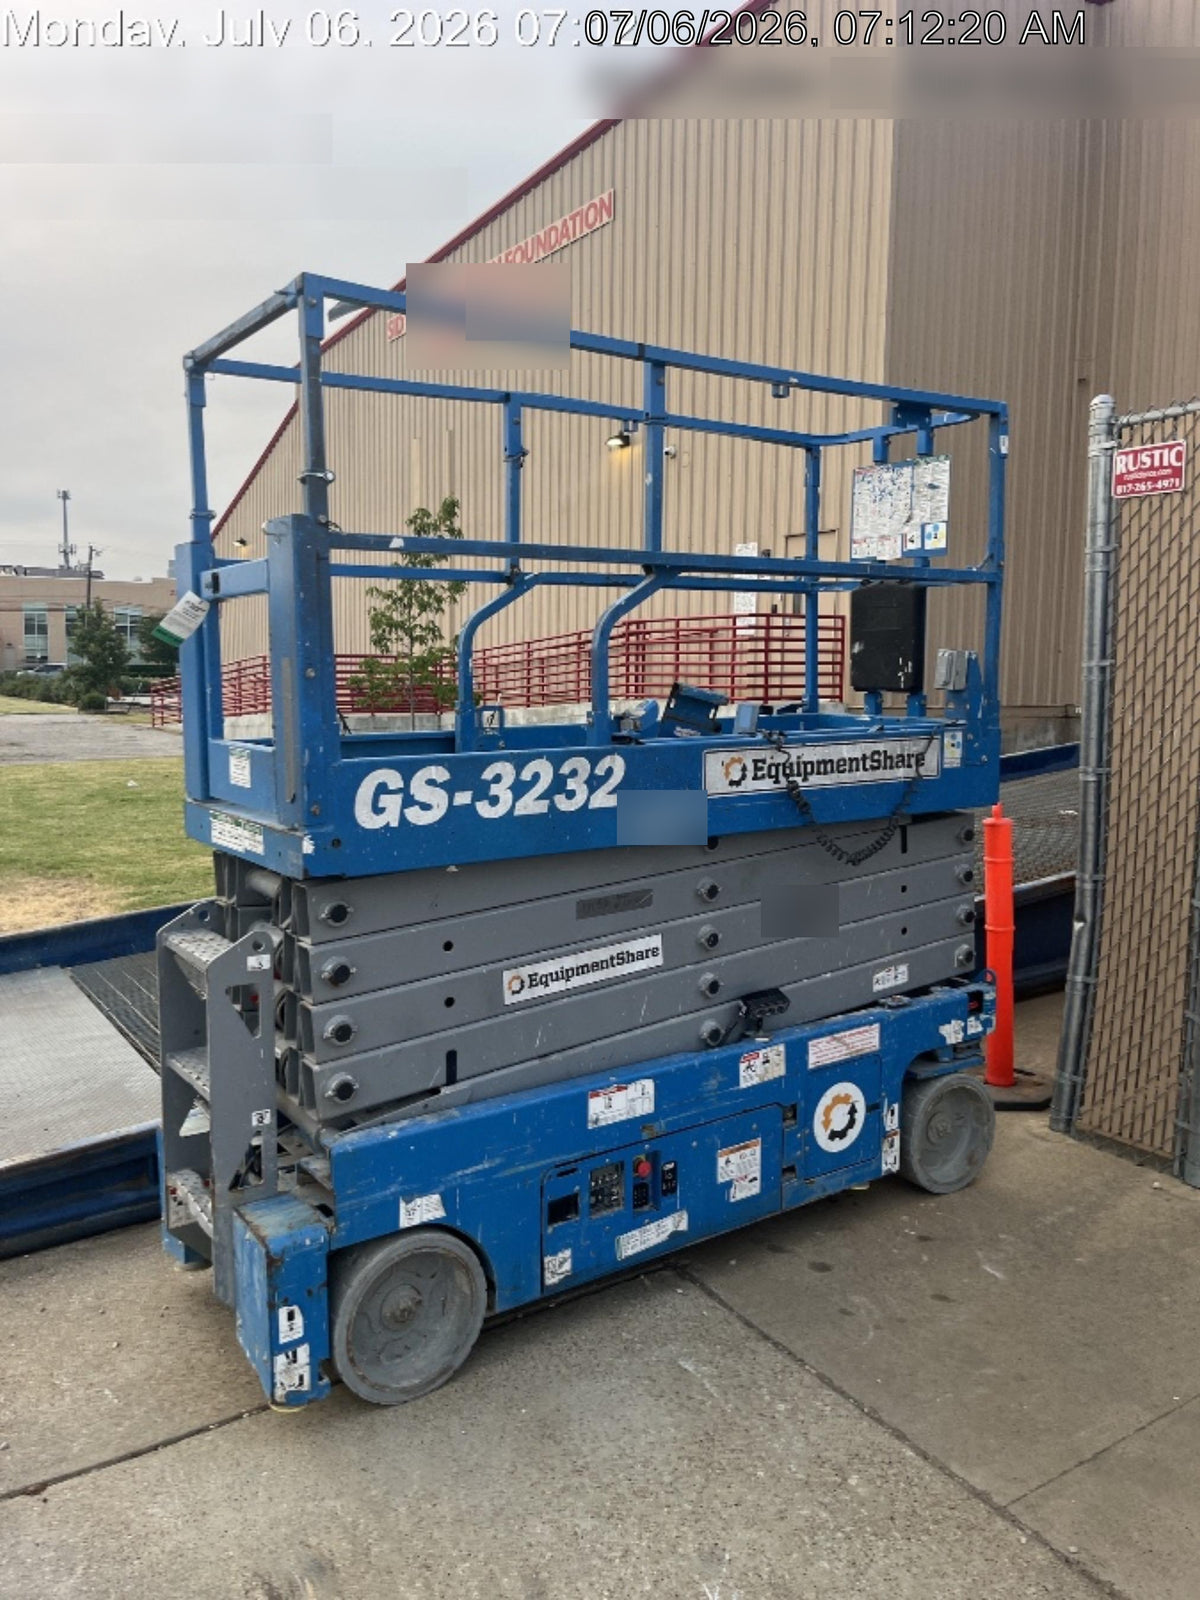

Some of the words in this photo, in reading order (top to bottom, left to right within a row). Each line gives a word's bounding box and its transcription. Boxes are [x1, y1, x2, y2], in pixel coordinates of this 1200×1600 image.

[1116, 446, 1184, 475] RUSTIC
[751, 749, 926, 785] EquipmentShare
[354, 753, 626, 829] GS-3232
[527, 946, 660, 989] EquipmentShare
